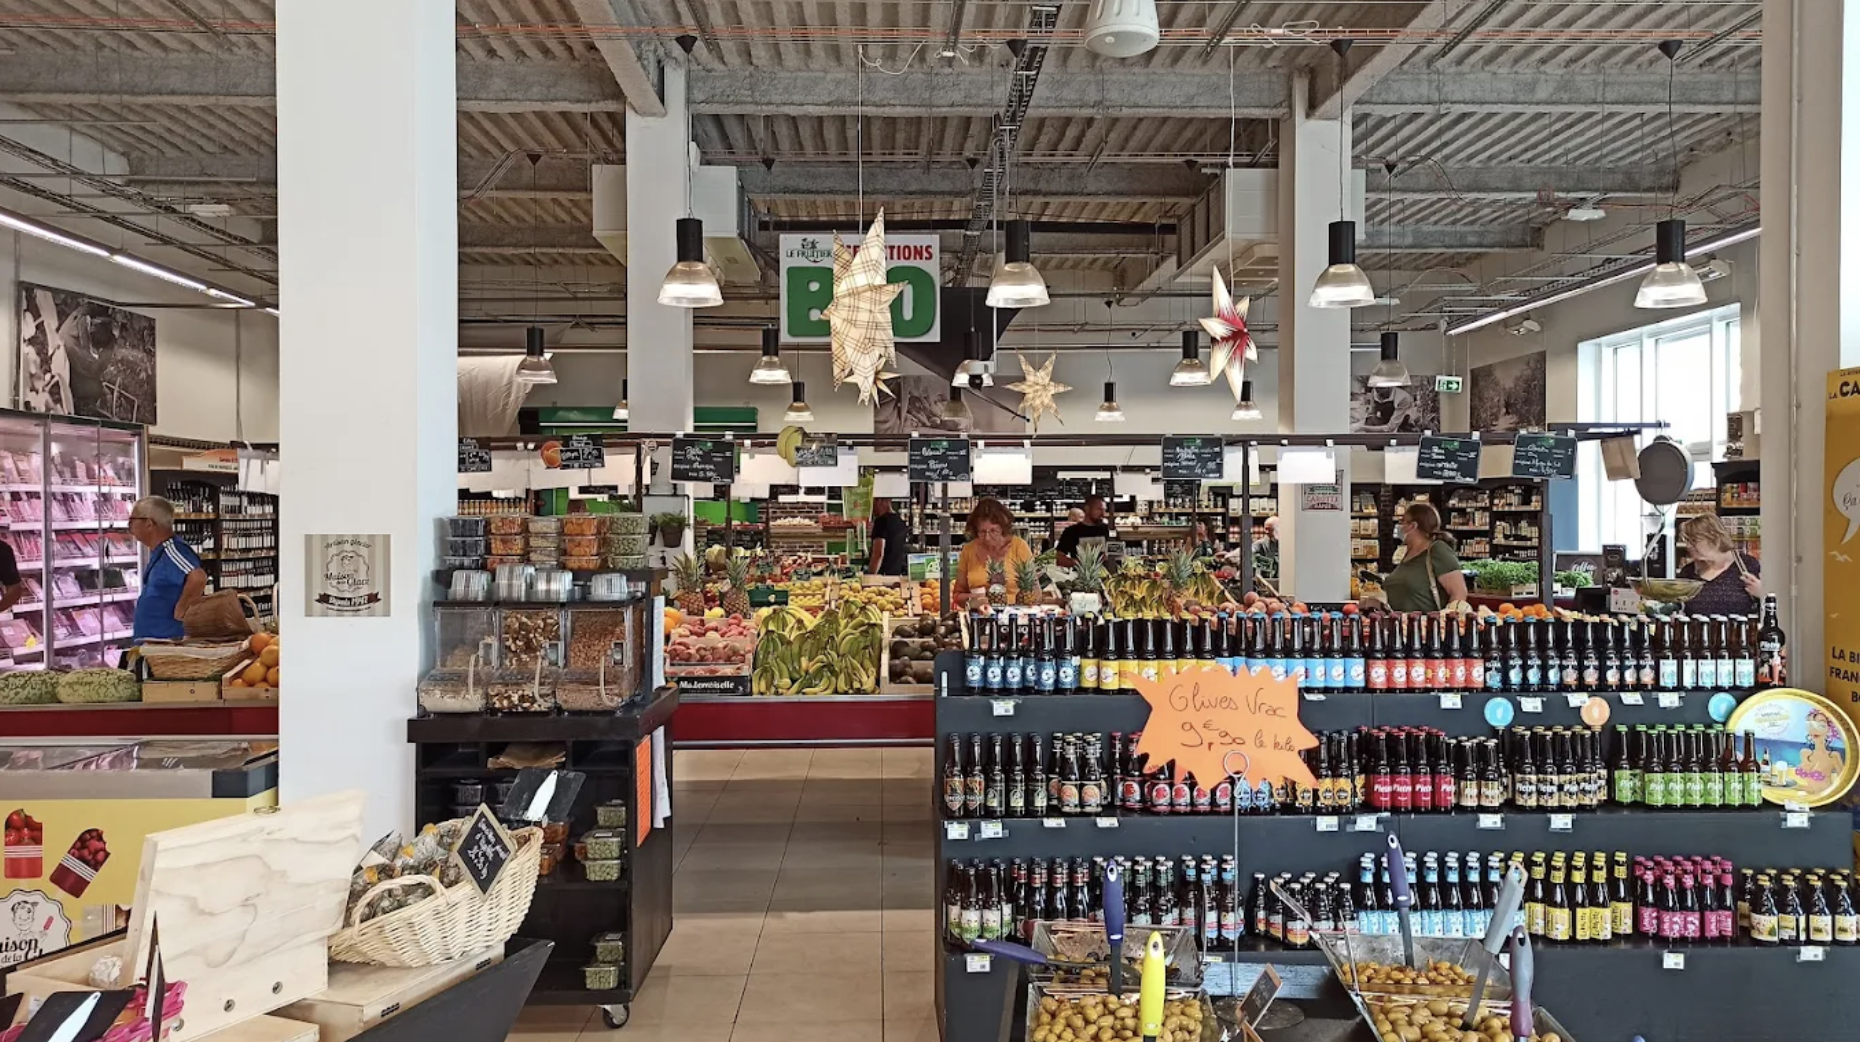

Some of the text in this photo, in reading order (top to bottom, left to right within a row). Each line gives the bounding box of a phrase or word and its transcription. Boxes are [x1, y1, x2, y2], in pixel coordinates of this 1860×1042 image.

[786, 265, 937, 338] BO
[1831, 646, 1846, 662] LA
[1245, 687, 1287, 718] Vrac
